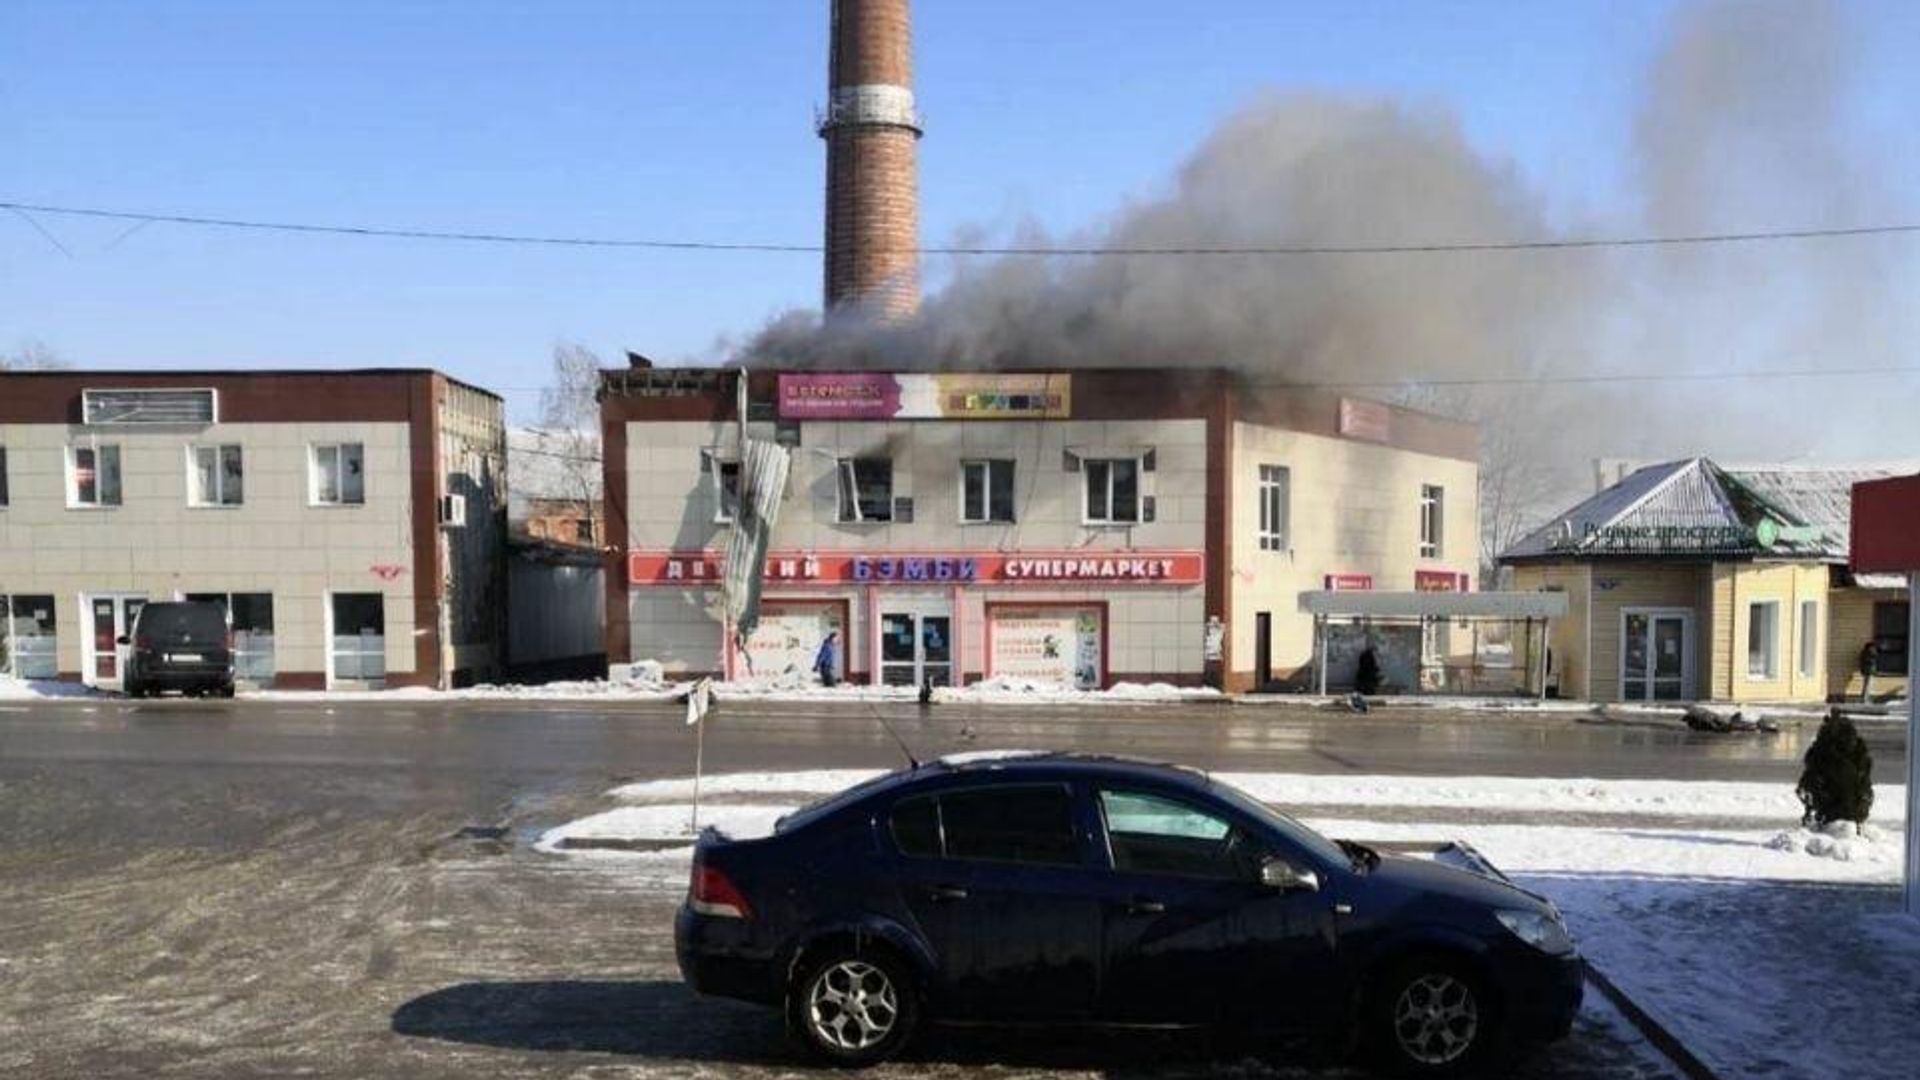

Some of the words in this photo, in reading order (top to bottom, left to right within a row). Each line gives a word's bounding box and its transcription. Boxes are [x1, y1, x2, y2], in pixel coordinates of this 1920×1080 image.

[667, 555, 820, 579] ДЕИЙ
[852, 556, 978, 580] БЭМБИ
[1004, 558, 1175, 577] СУПЕРМАРКЕТ
